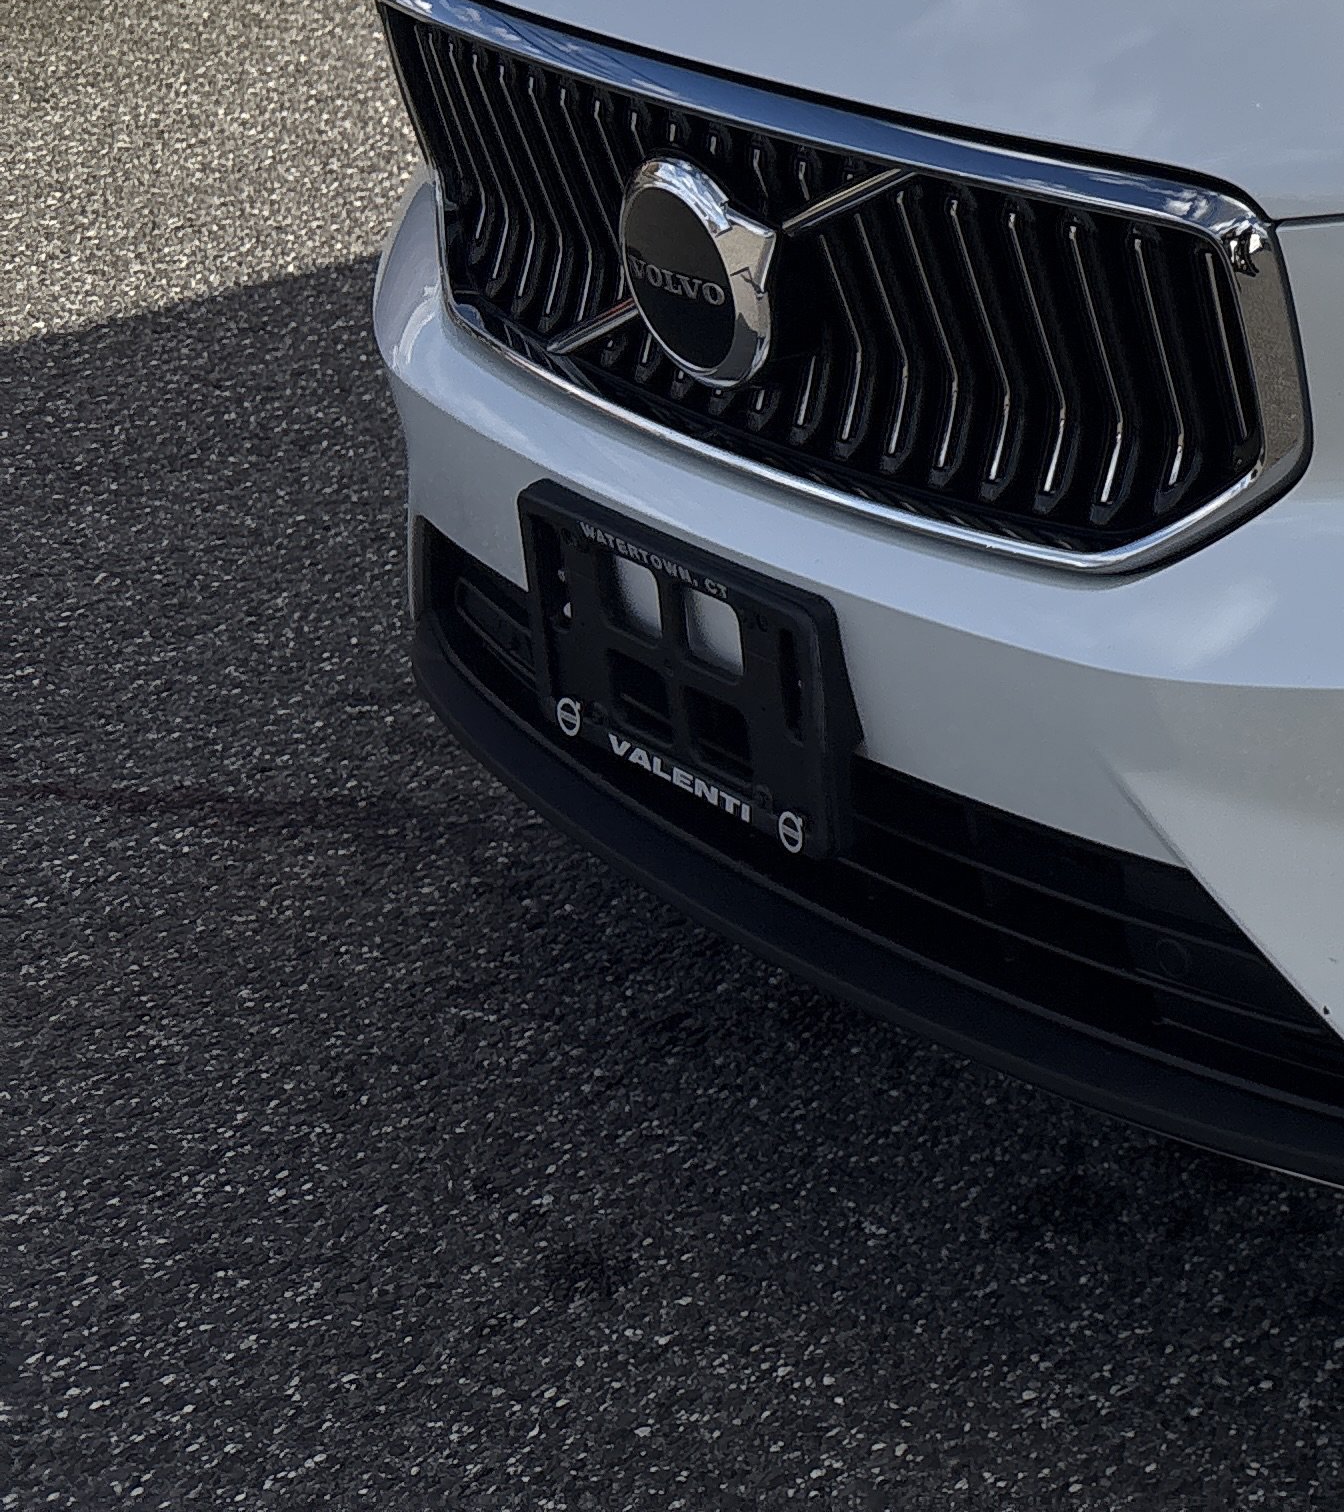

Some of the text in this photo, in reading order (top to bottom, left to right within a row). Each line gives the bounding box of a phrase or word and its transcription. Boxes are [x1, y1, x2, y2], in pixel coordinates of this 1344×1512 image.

[628, 254, 725, 306] VOLVO
[704, 577, 728, 599] CT
[608, 733, 750, 824] VALENTI
